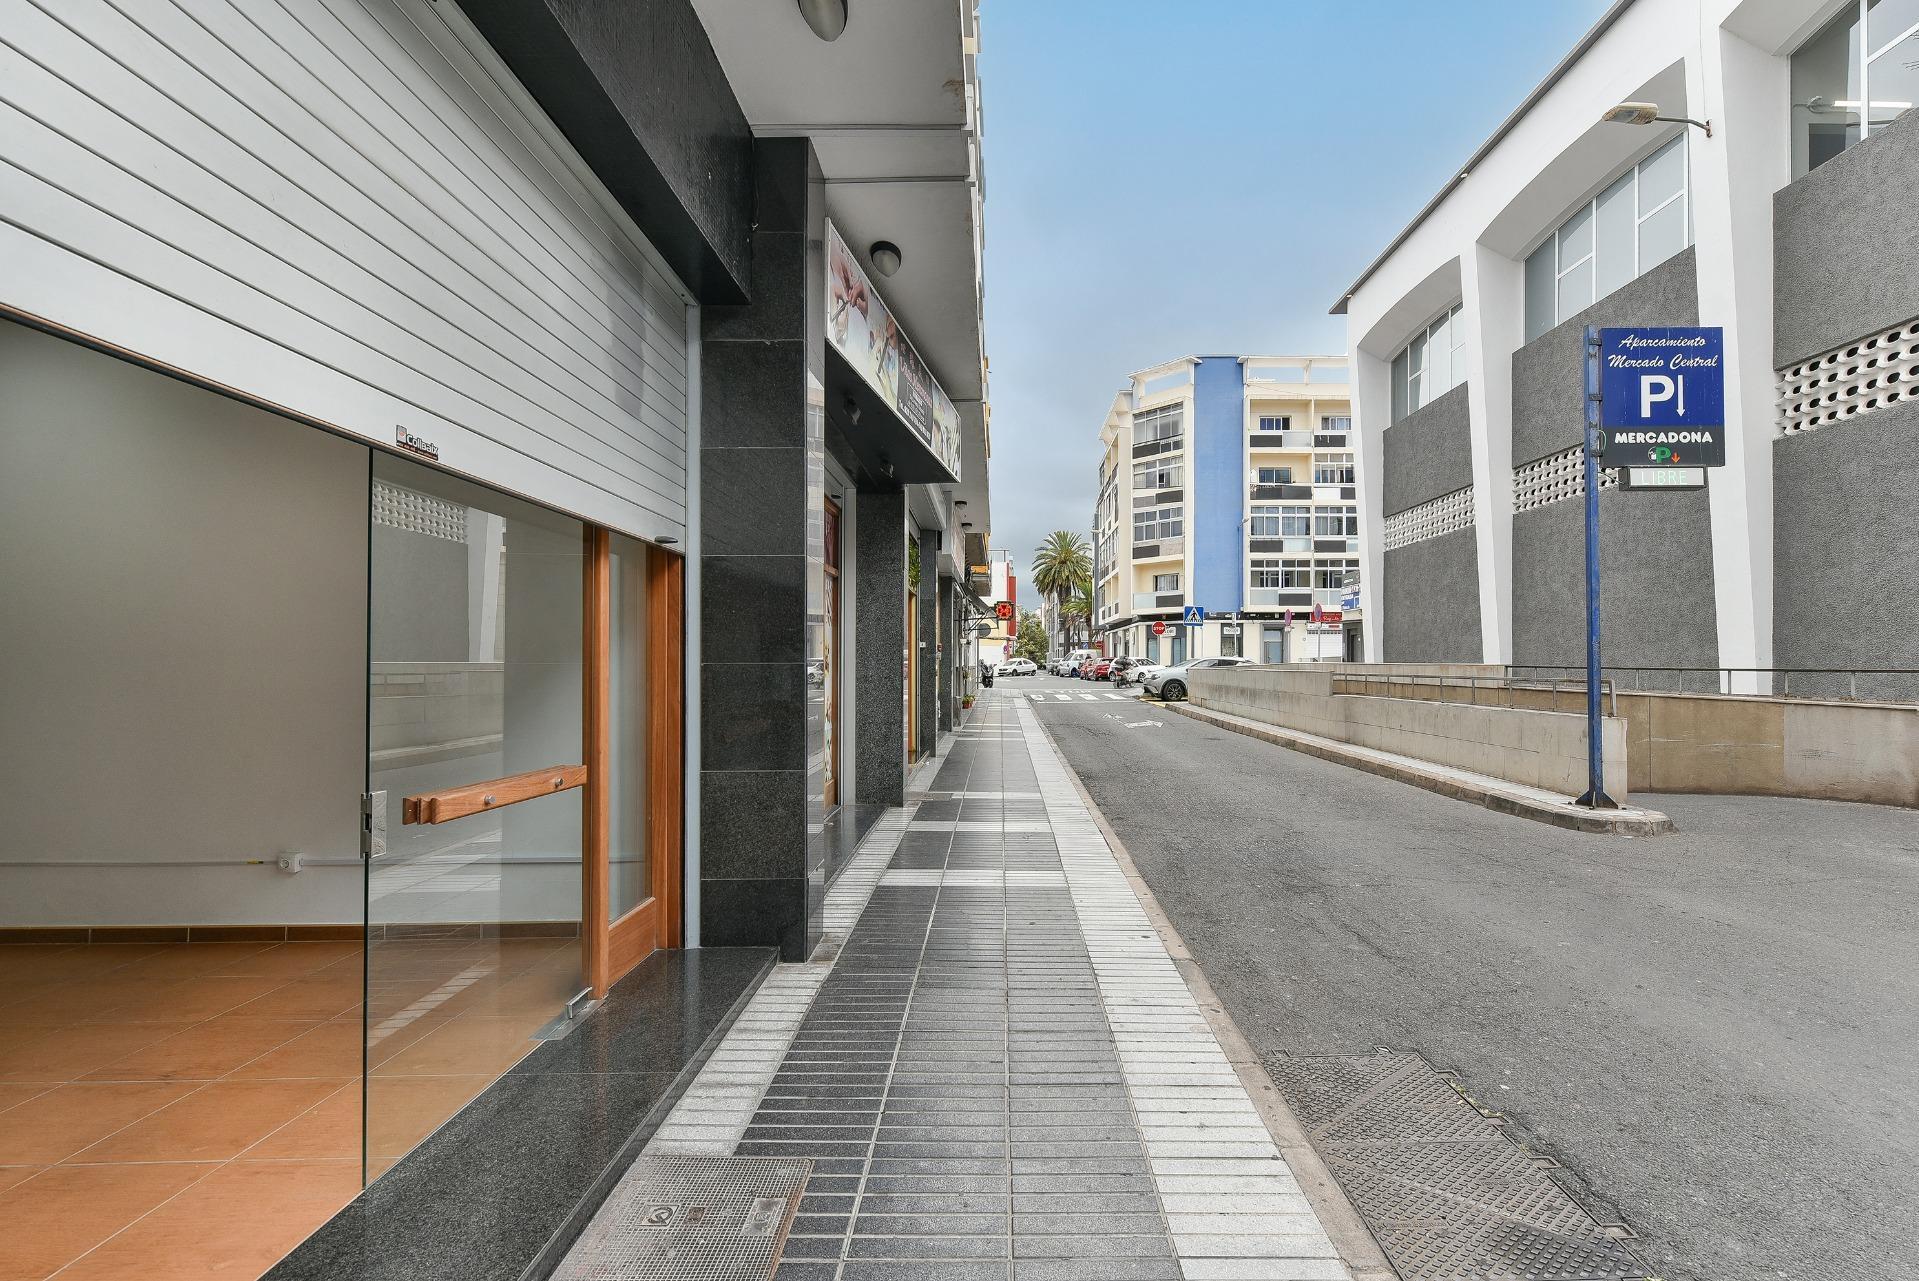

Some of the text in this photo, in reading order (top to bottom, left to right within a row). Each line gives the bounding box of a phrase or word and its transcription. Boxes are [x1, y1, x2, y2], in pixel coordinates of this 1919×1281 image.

[1618, 334, 1707, 350] Aparcamiento
[1608, 353, 1719, 370] Mercado Central
[1640, 375, 1675, 418] P
[1614, 431, 1713, 444] MERCADONA
[1640, 470, 1688, 485] LIBRE
